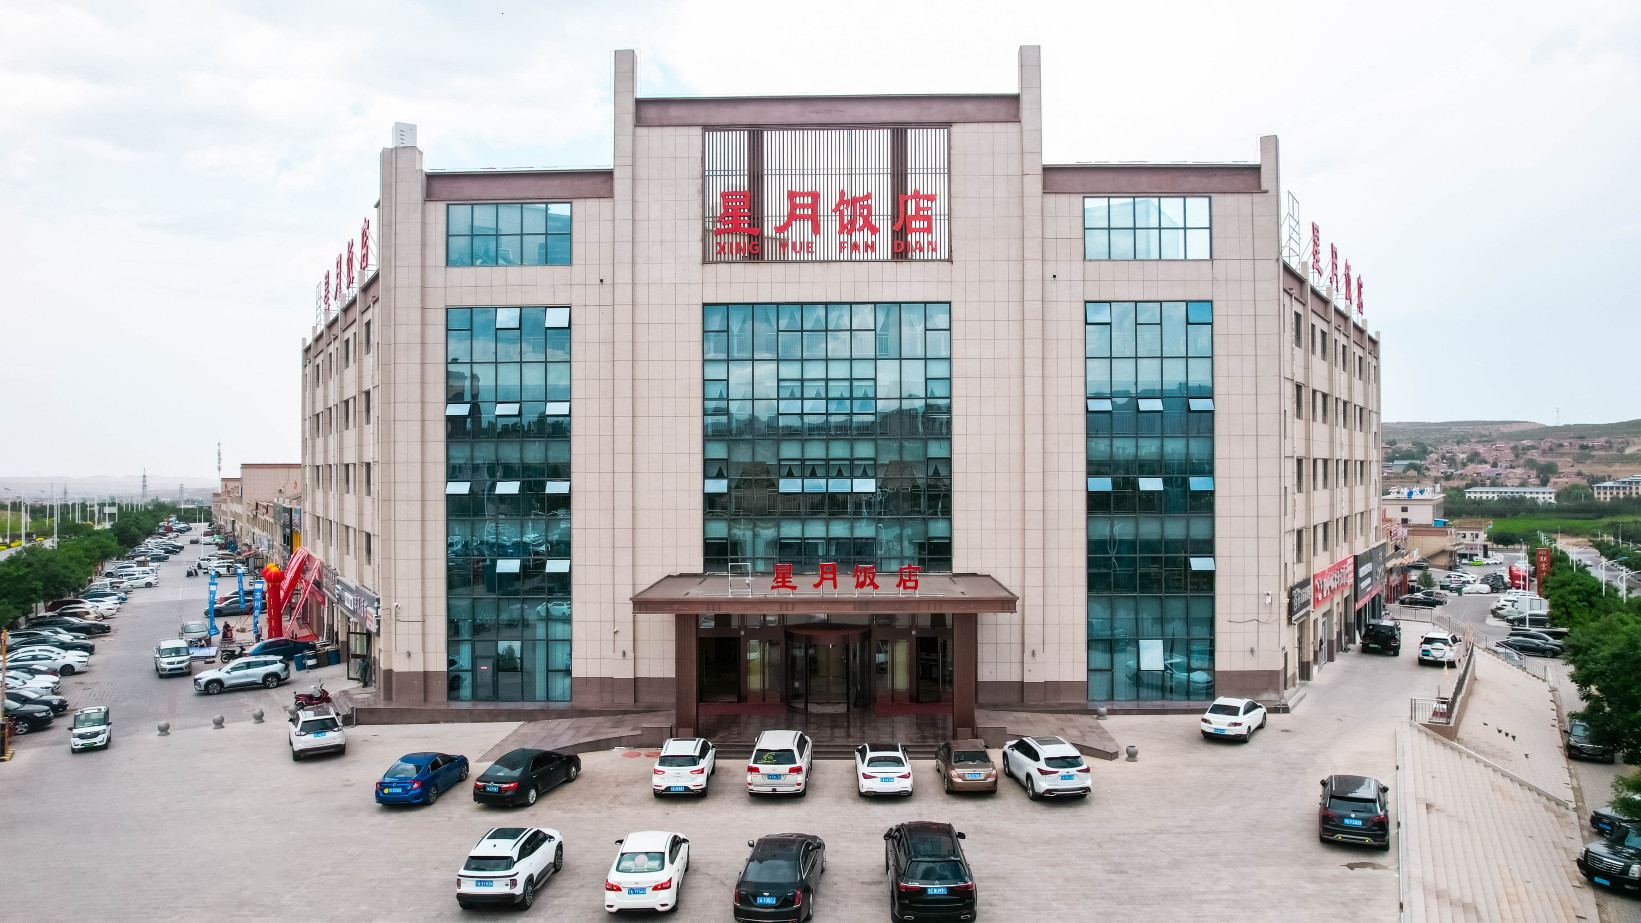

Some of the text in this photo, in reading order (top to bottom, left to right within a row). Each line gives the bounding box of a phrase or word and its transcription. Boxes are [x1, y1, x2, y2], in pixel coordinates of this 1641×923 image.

[714, 188, 938, 236] 星月饭店
[716, 240, 938, 255] XING YUE FAN DIAN
[771, 562, 922, 591] 星月饭店
